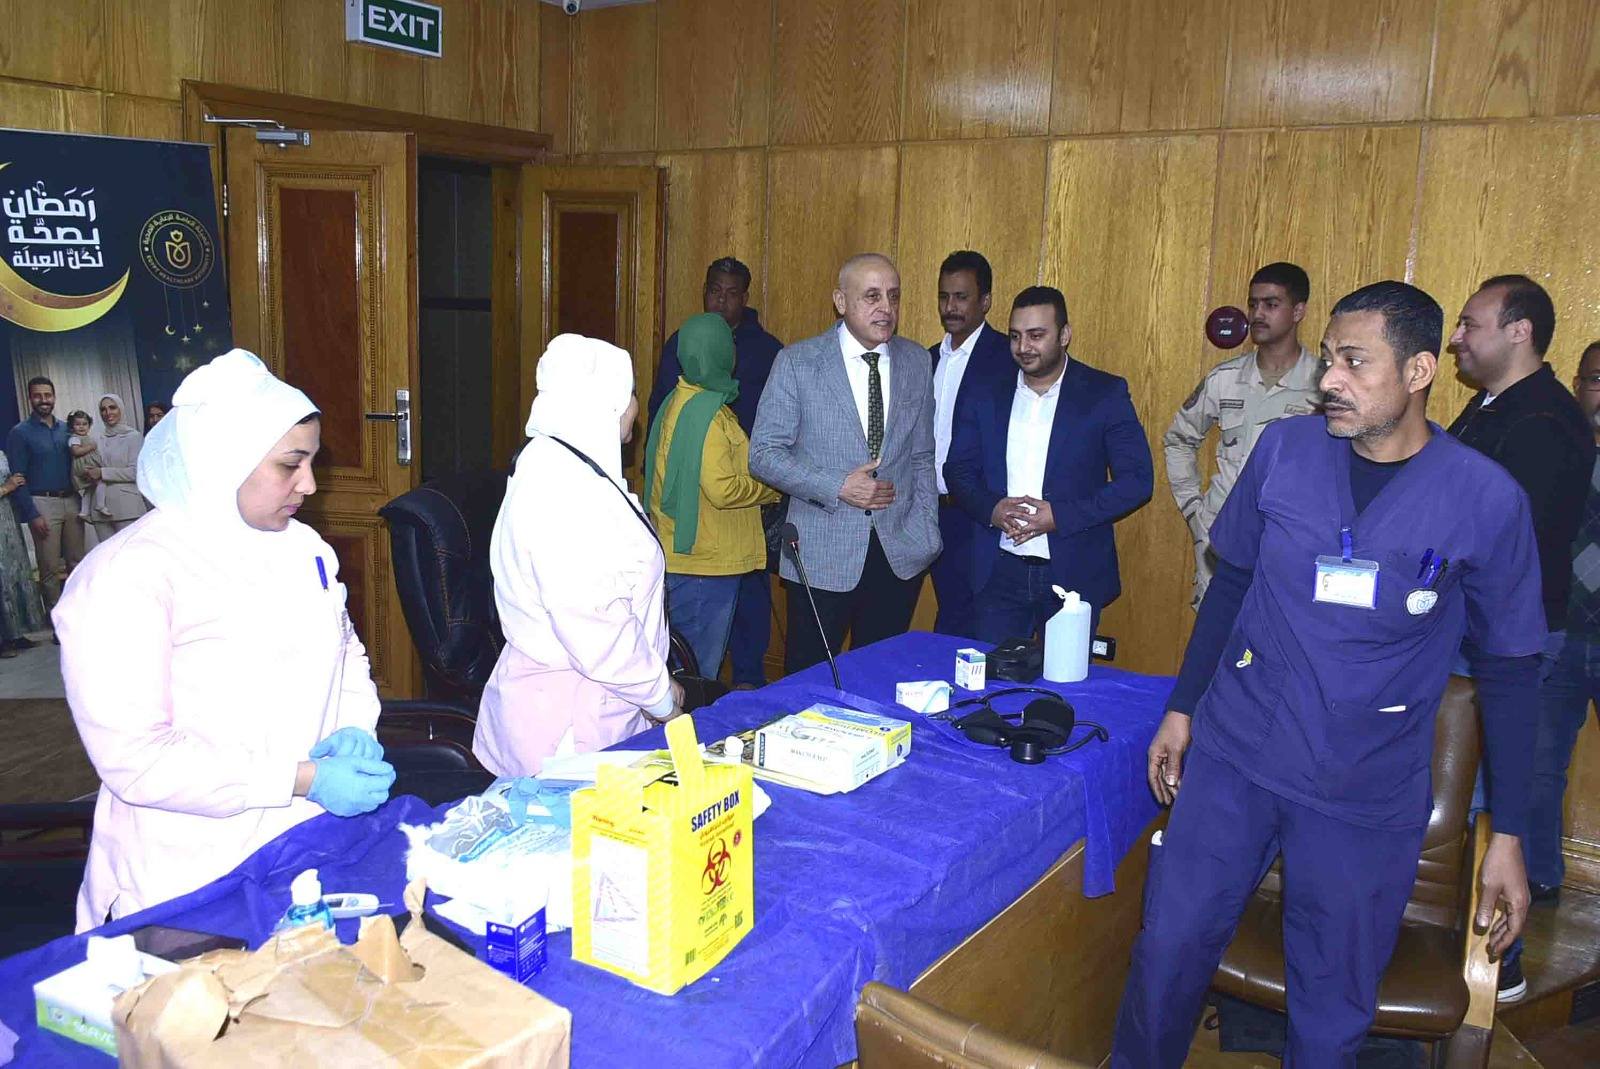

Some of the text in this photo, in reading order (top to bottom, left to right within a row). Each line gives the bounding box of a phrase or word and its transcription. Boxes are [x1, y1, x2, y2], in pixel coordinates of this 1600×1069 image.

[368, 4, 435, 41] EXIT
[691, 800, 722, 833] SAFETY
[723, 789, 740, 813] BOX
